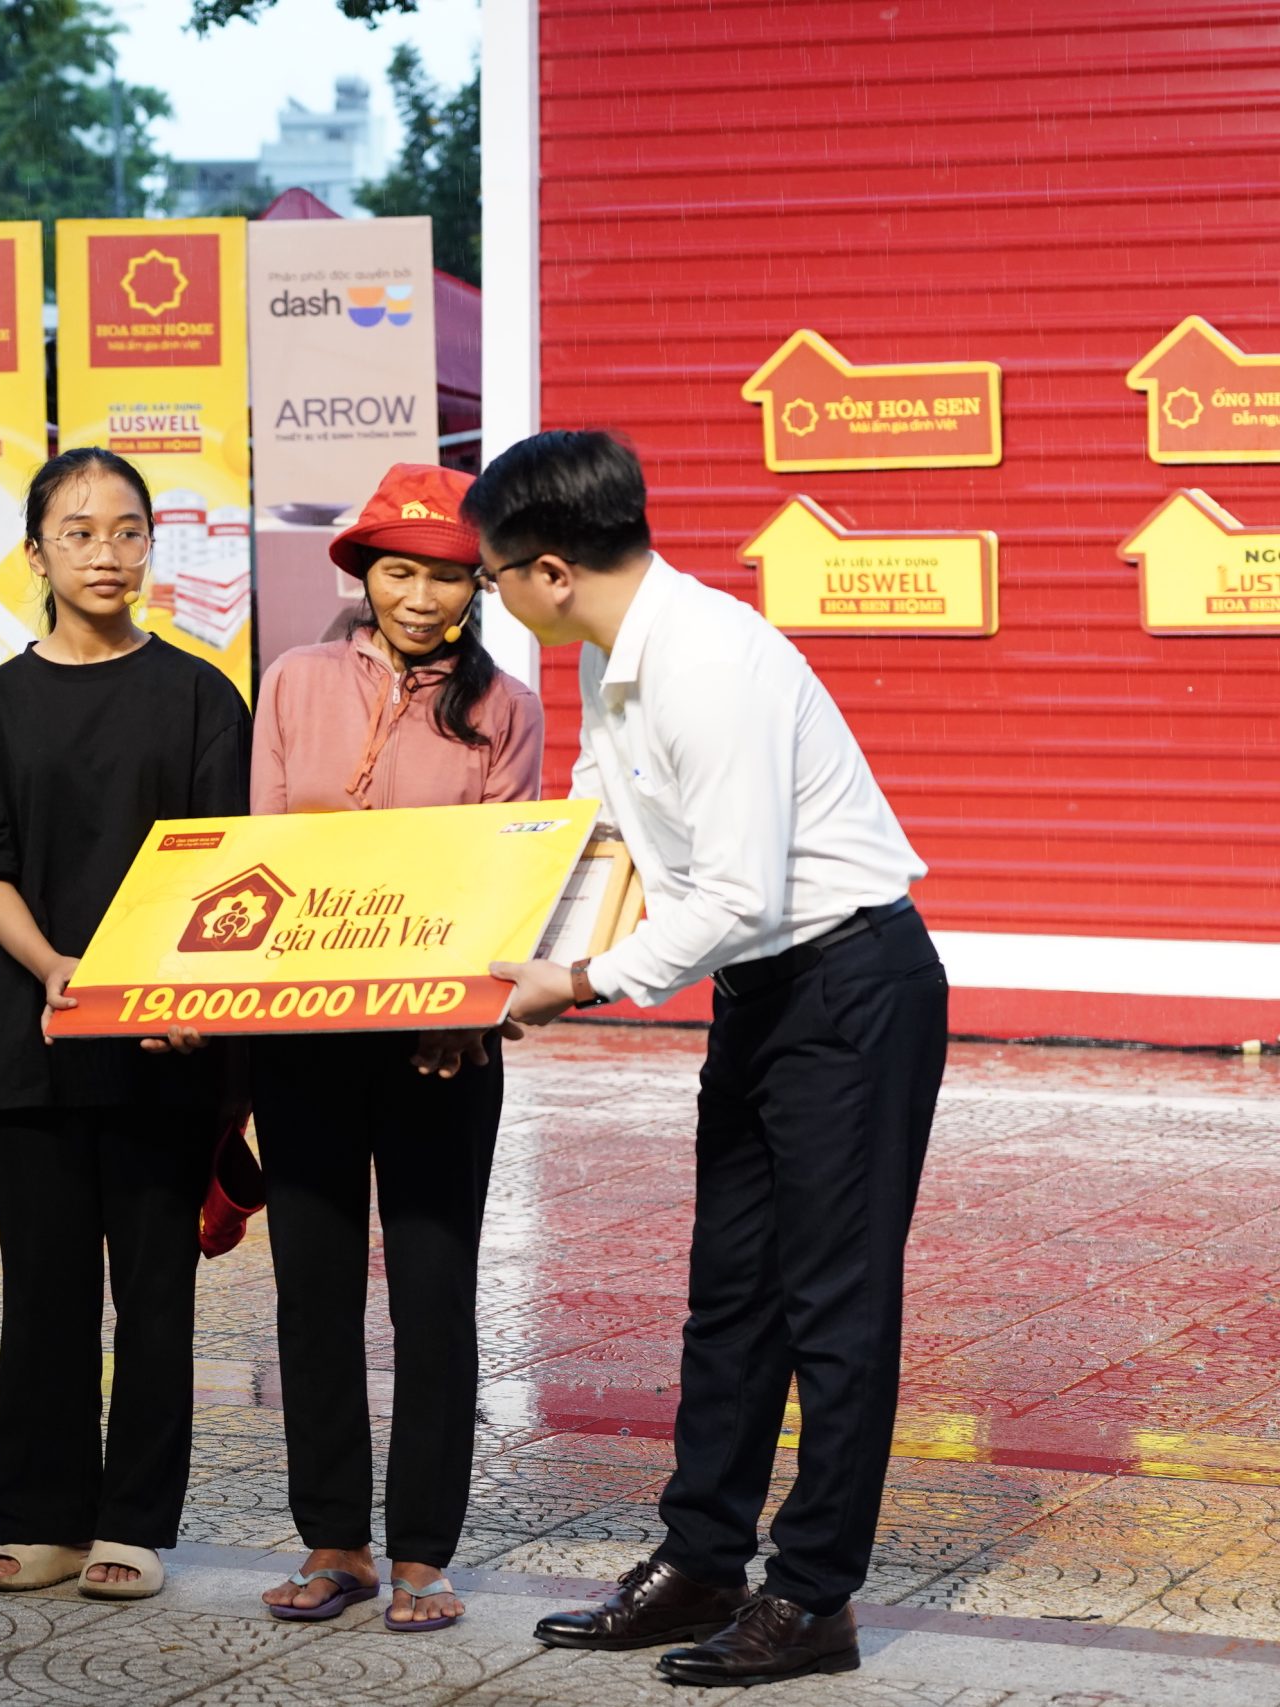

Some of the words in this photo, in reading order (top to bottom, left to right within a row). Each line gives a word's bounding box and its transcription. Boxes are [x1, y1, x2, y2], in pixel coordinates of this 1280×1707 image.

[270, 288, 342, 317] dash
[96, 324, 128, 337] HOA
[130, 323, 162, 337] SEN
[164, 322, 214, 336] HOME
[825, 395, 873, 420] TÔN
[879, 399, 929, 418] HOA
[933, 397, 981, 416] SEN
[1211, 387, 1251, 408] ỐNG
[275, 395, 416, 428] ARROW
[109, 415, 200, 432] LUSWELL
[827, 573, 937, 593] LUSWELL
[825, 600, 858, 613] HOA
[859, 600, 891, 613] SEN
[893, 598, 943, 614] HOME
[1212, 598, 1249, 612] HOA
[296, 887, 356, 918] Mái
[355, 884, 405, 917] ấm
[265, 923, 316, 960] gia
[321, 918, 391, 950] đình
[398, 915, 456, 951] Việt
[118, 985, 355, 1022] 19.000.000
[365, 981, 466, 1016] VNĐ
